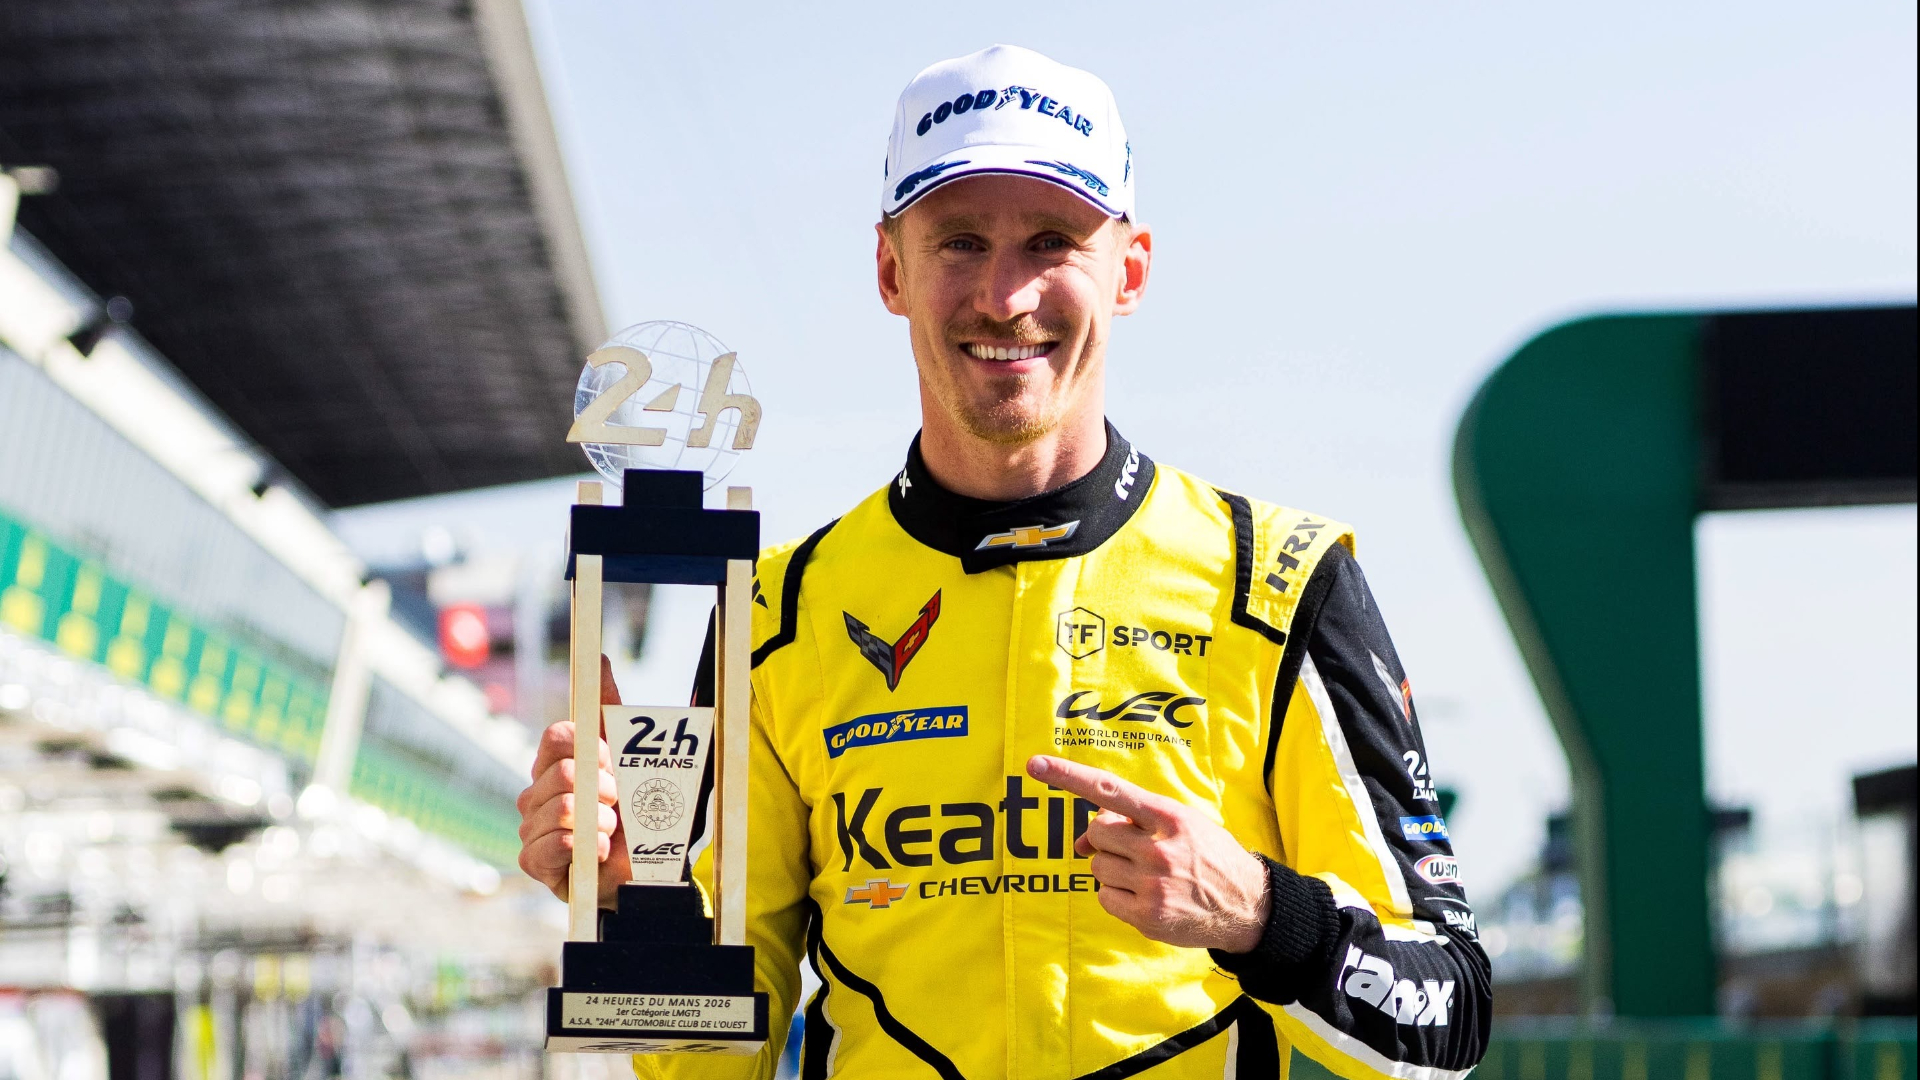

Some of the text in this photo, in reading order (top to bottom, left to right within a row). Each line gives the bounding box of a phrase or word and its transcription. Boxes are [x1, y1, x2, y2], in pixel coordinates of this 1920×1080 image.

[917, 86, 1094, 137] GOODYEAR
[565, 346, 762, 450] 24h
[1064, 621, 1213, 657] TF SPORT
[1056, 691, 1206, 728] WEC
[622, 716, 699, 756] 24h
[830, 713, 964, 749] GOODYEAR
[1055, 727, 1192, 748] FIA WORLD ENDURANCE
[1055, 737, 1145, 750] CHAMPIONSHIP
[619, 757, 694, 769] LE MANS
[633, 843, 685, 855] WEC
[586, 996, 731, 1008] 24 HEURES DU MANS 2026
[569, 1017, 747, 1029] A.S.A. "24H" AUTOMOBILE CLUB DE L'OUEST
[616, 1008, 701, 1018] 1er Catégorie LMGT3
